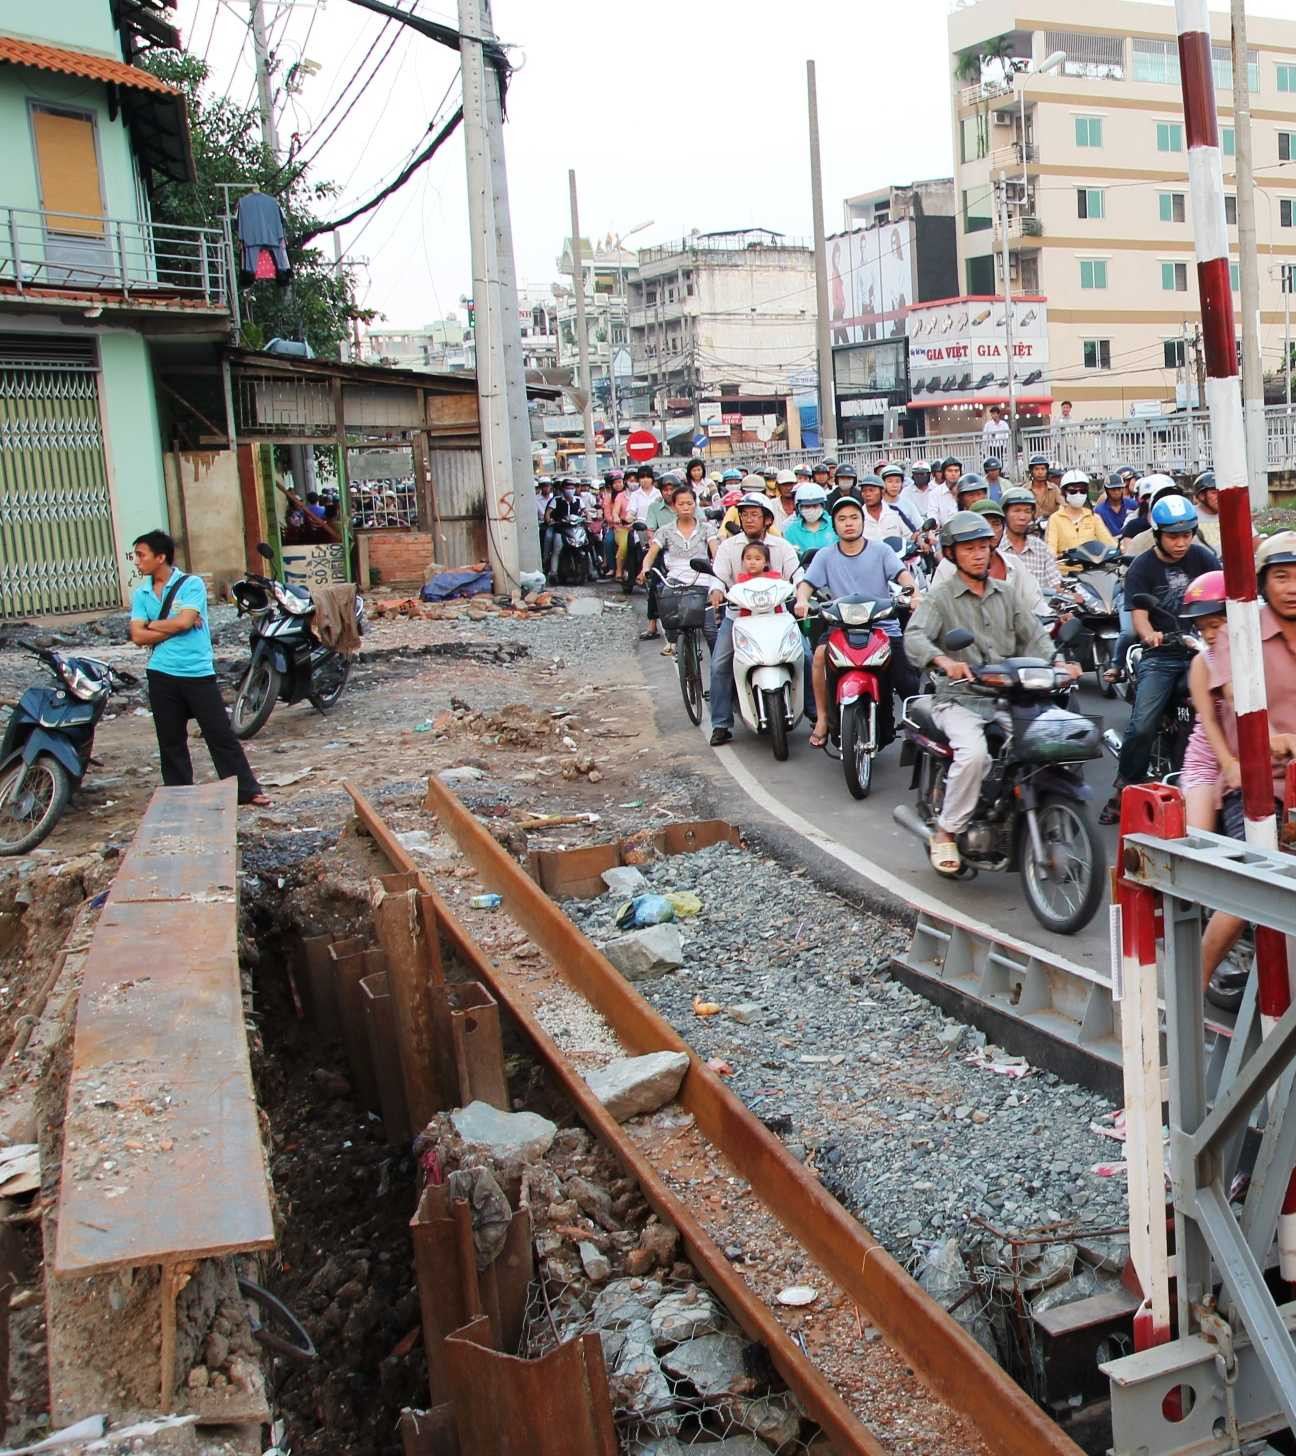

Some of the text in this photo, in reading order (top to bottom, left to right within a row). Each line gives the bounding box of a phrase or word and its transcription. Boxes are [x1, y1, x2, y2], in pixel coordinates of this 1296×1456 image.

[927, 347, 944, 361] GIA
[945, 342, 969, 360] VIỆT
[977, 344, 1001, 357] GIA
